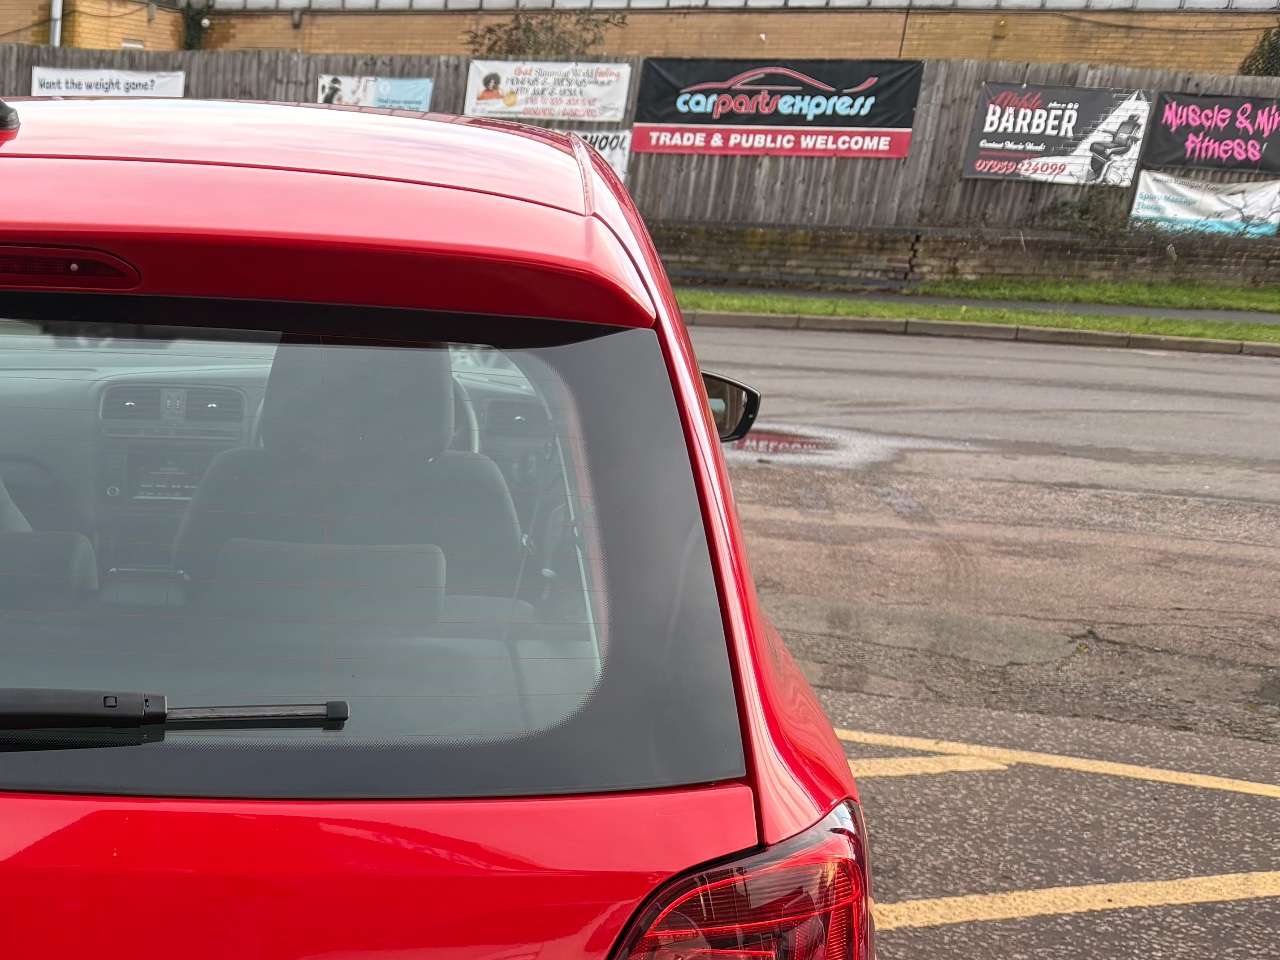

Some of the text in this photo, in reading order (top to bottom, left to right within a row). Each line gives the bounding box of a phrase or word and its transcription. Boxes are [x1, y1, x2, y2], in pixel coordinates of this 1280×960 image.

[39, 78, 61, 90] Want
[65, 78, 82, 90] the
[85, 79, 120, 93] weight
[676, 90, 876, 121] carpartsexpress
[983, 103, 1078, 137] BARBER
[1162, 101, 1232, 132] Muscle
[1235, 103, 1254, 135] &
[649, 131, 891, 151] TRADE & PUBLIC WELCOME
[1185, 132, 1261, 161] Fitness
